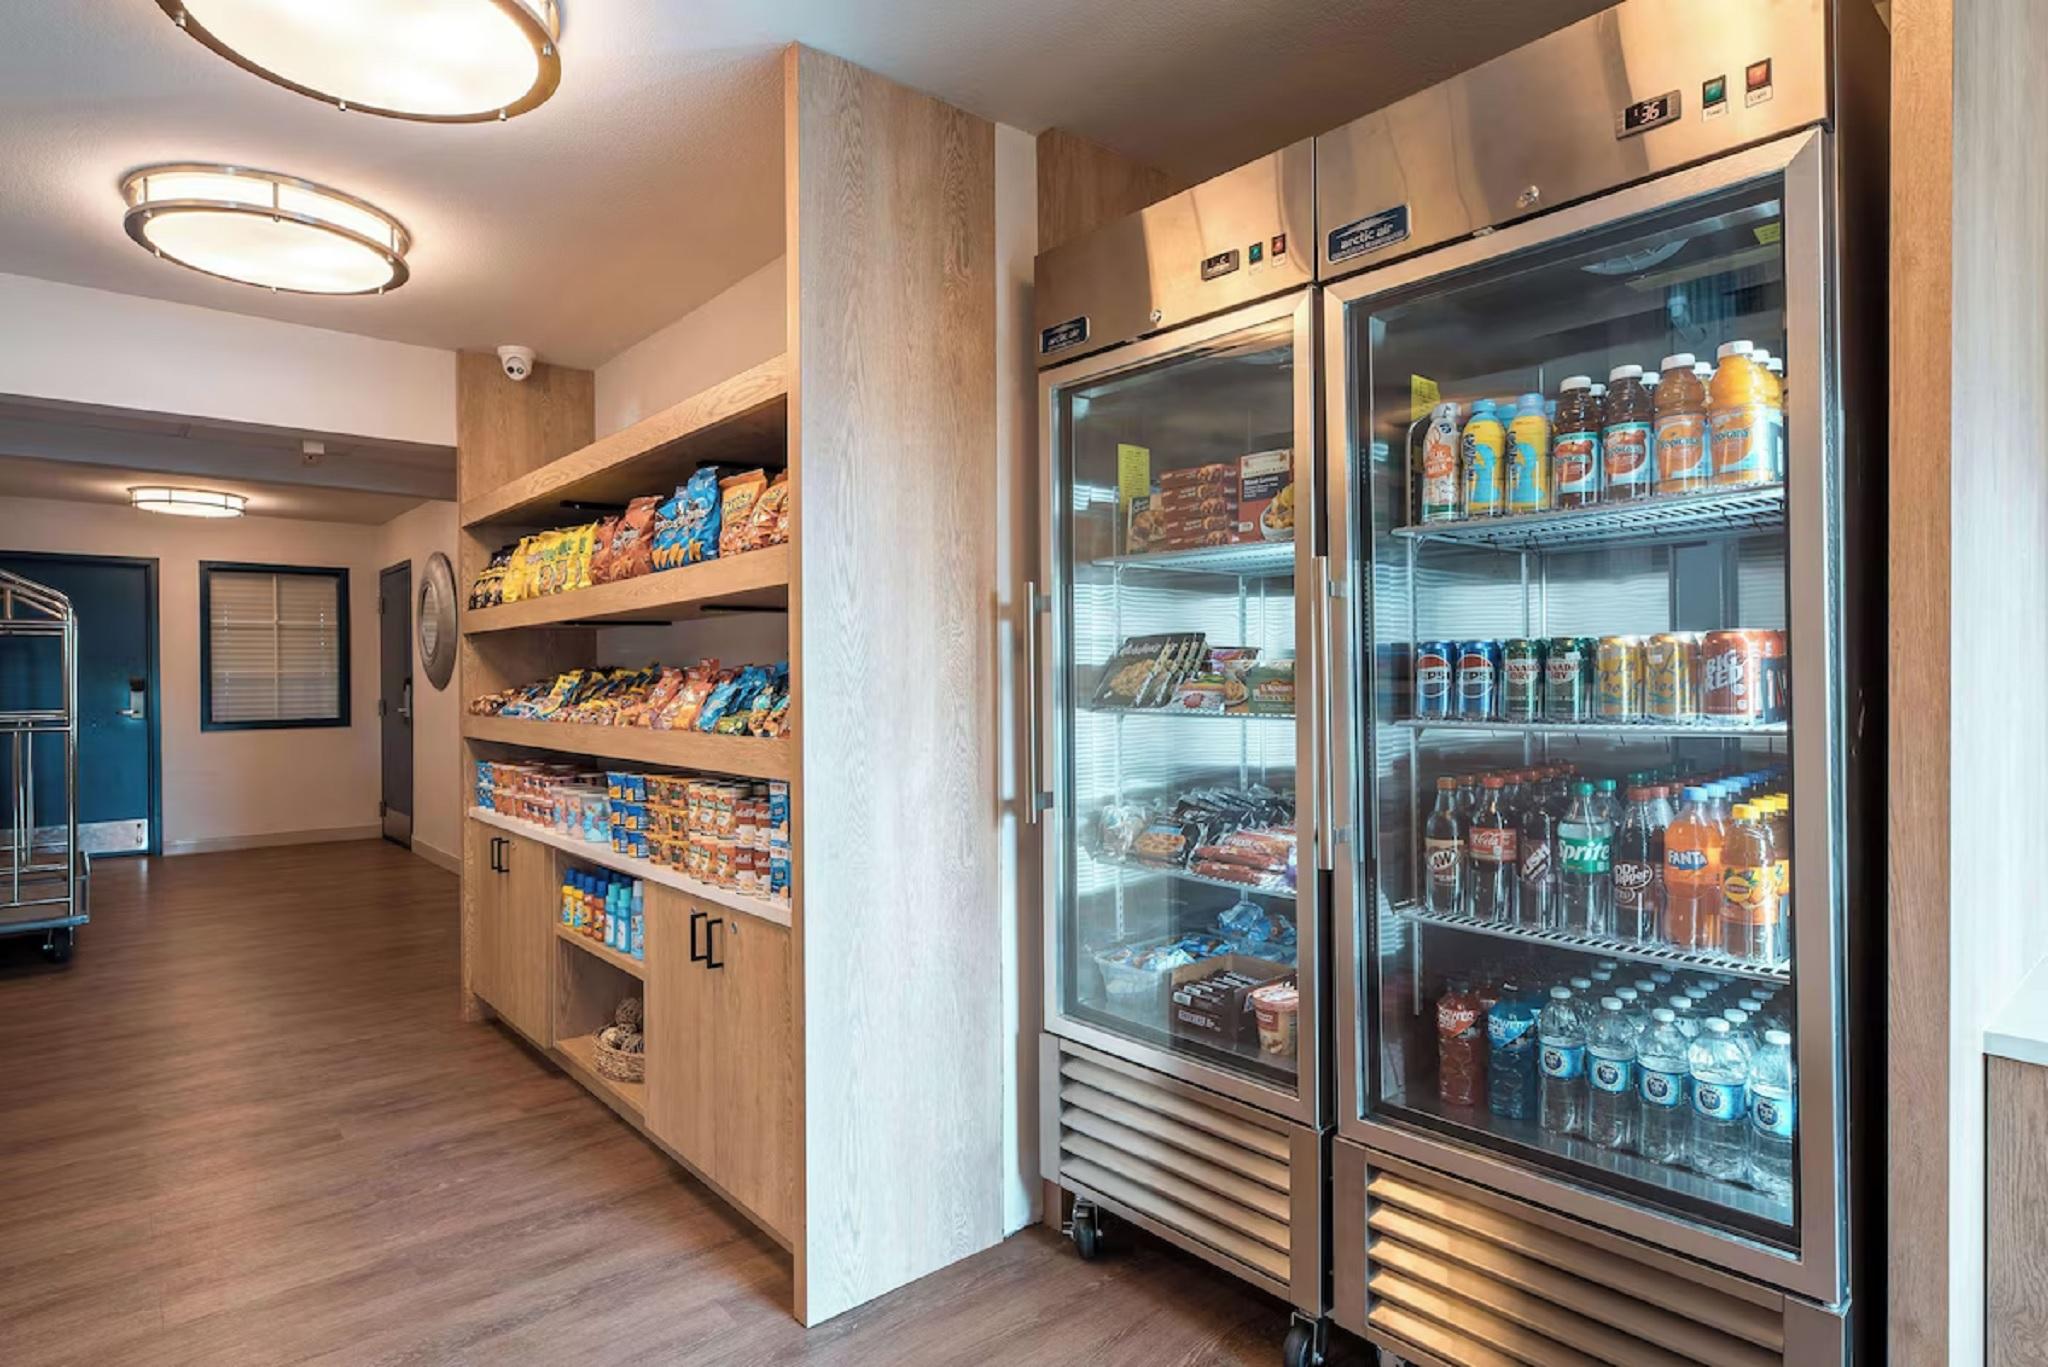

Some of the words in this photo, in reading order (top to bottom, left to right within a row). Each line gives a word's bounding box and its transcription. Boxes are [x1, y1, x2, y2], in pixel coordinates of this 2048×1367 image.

[1640, 101, 1660, 124] 36
[1340, 229, 1375, 250] arctic
[1376, 223, 1394, 237] air
[1706, 649, 1737, 674] BIG
[1705, 665, 1745, 694] RED
[1559, 839, 1610, 863] Sprite
[1667, 850, 1708, 866] FANTA
